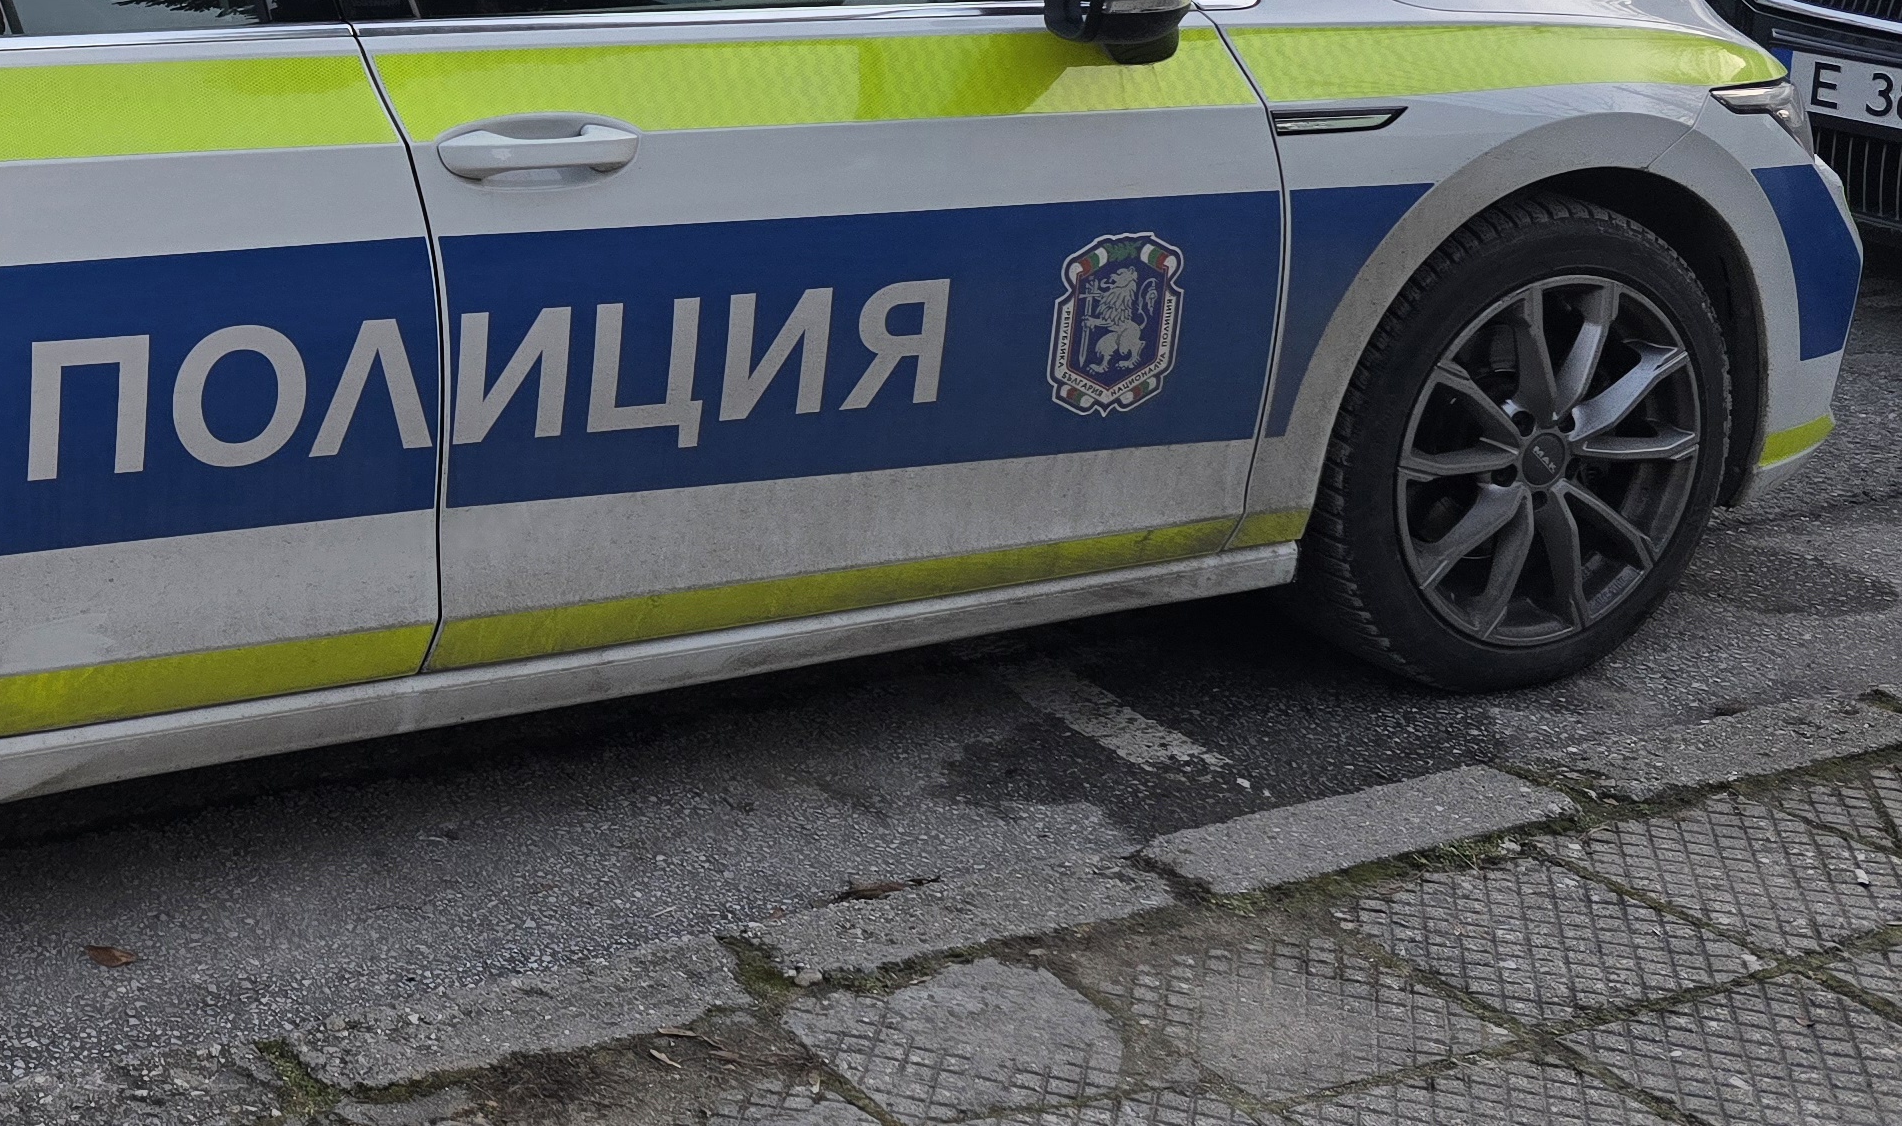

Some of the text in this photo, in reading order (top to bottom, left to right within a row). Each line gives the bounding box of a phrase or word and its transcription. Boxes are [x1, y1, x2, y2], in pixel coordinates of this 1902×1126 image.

[1810, 61, 1902, 121] E 3
[27, 277, 951, 480] ПОЛИЦИЯ
[1057, 298, 1173, 398] РЕПУБЛИКА БЪЛГАРИЯ НАЦИОНАЛНА ПОЛИЦИЯ
